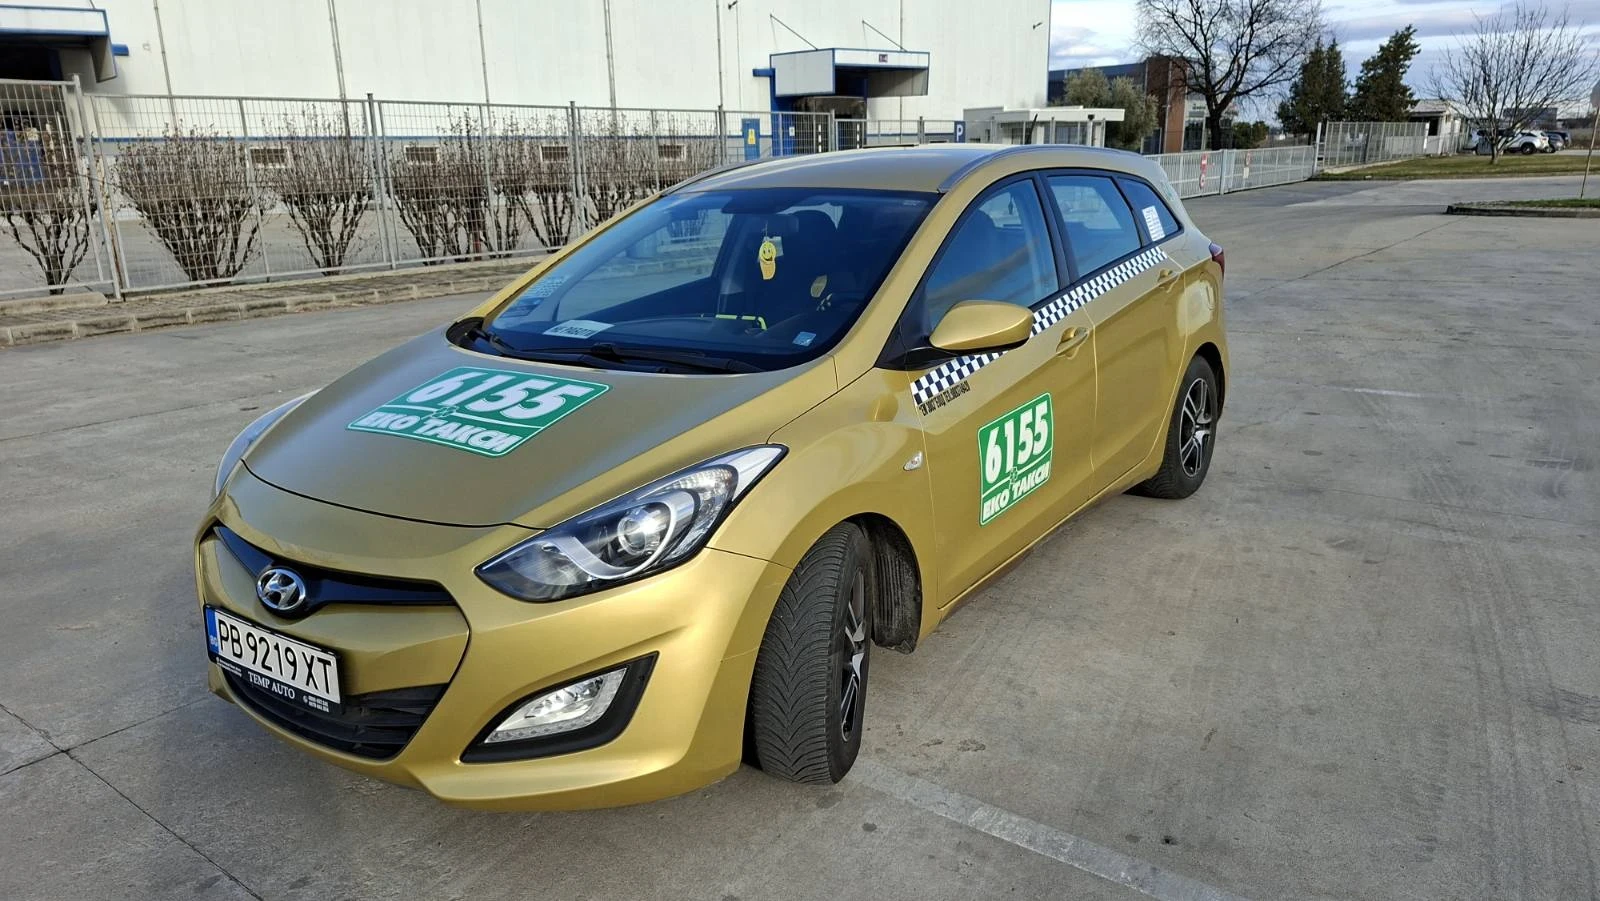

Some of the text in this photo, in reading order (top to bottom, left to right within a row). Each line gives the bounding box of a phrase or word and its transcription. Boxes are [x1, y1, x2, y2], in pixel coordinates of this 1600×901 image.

[956, 124, 964, 142] P
[406, 371, 595, 420] 6155
[356, 411, 524, 452] ЕКО ТАКСИ
[985, 400, 1049, 484] 6155
[982, 460, 1051, 521] ЕКО ТАКСИ
[218, 619, 243, 659] PB
[246, 632, 298, 681] 9219
[302, 651, 332, 694] XT
[248, 671, 296, 700] TEMP AUTO
